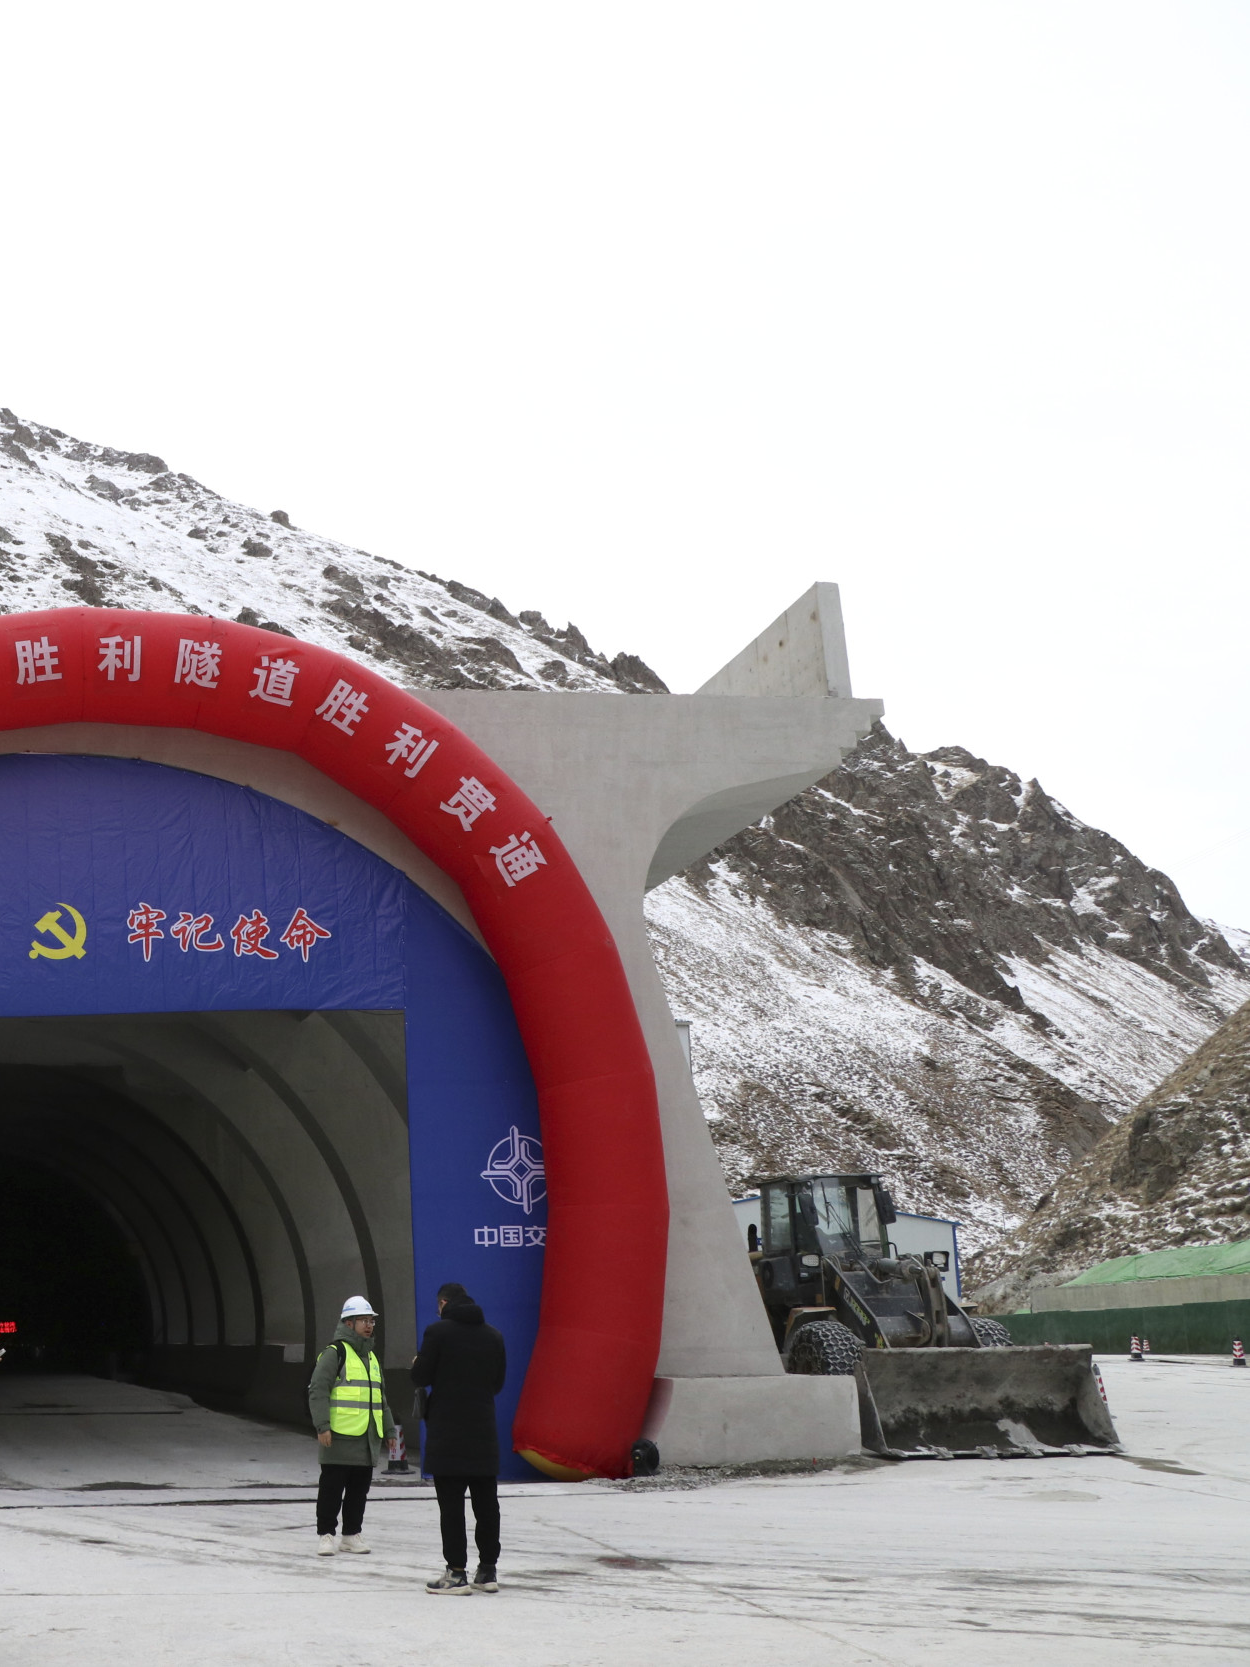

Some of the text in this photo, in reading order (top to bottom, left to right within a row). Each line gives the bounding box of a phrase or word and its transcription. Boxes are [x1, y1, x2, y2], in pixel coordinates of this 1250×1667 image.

[127, 903, 331, 962] 牢记使命
[474, 1225, 547, 1247] 中国交
